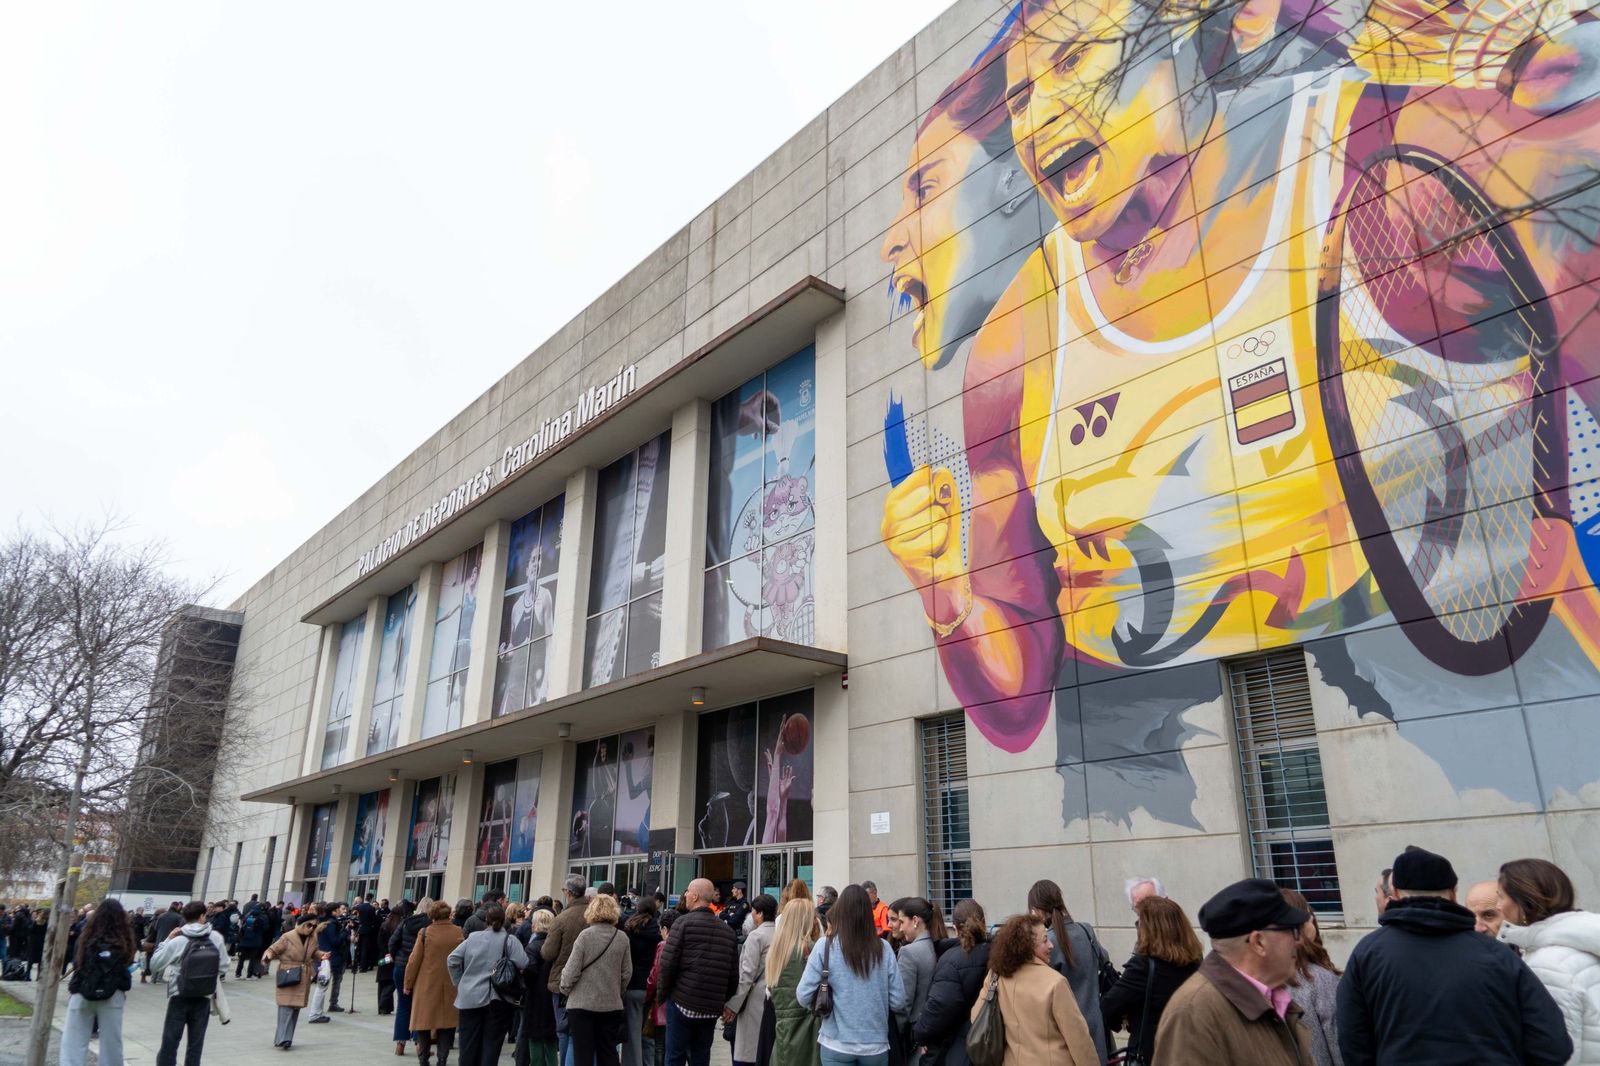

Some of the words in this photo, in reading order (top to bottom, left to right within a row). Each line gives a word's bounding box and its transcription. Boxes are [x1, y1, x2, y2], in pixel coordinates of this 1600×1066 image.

[1236, 366, 1276, 387] ESPAÑA
[357, 530, 402, 577] PALACIO
[405, 515, 421, 545] DE
[421, 465, 493, 534] DEPORTES
[501, 410, 573, 478] Carolina
[576, 364, 637, 428] Marín
